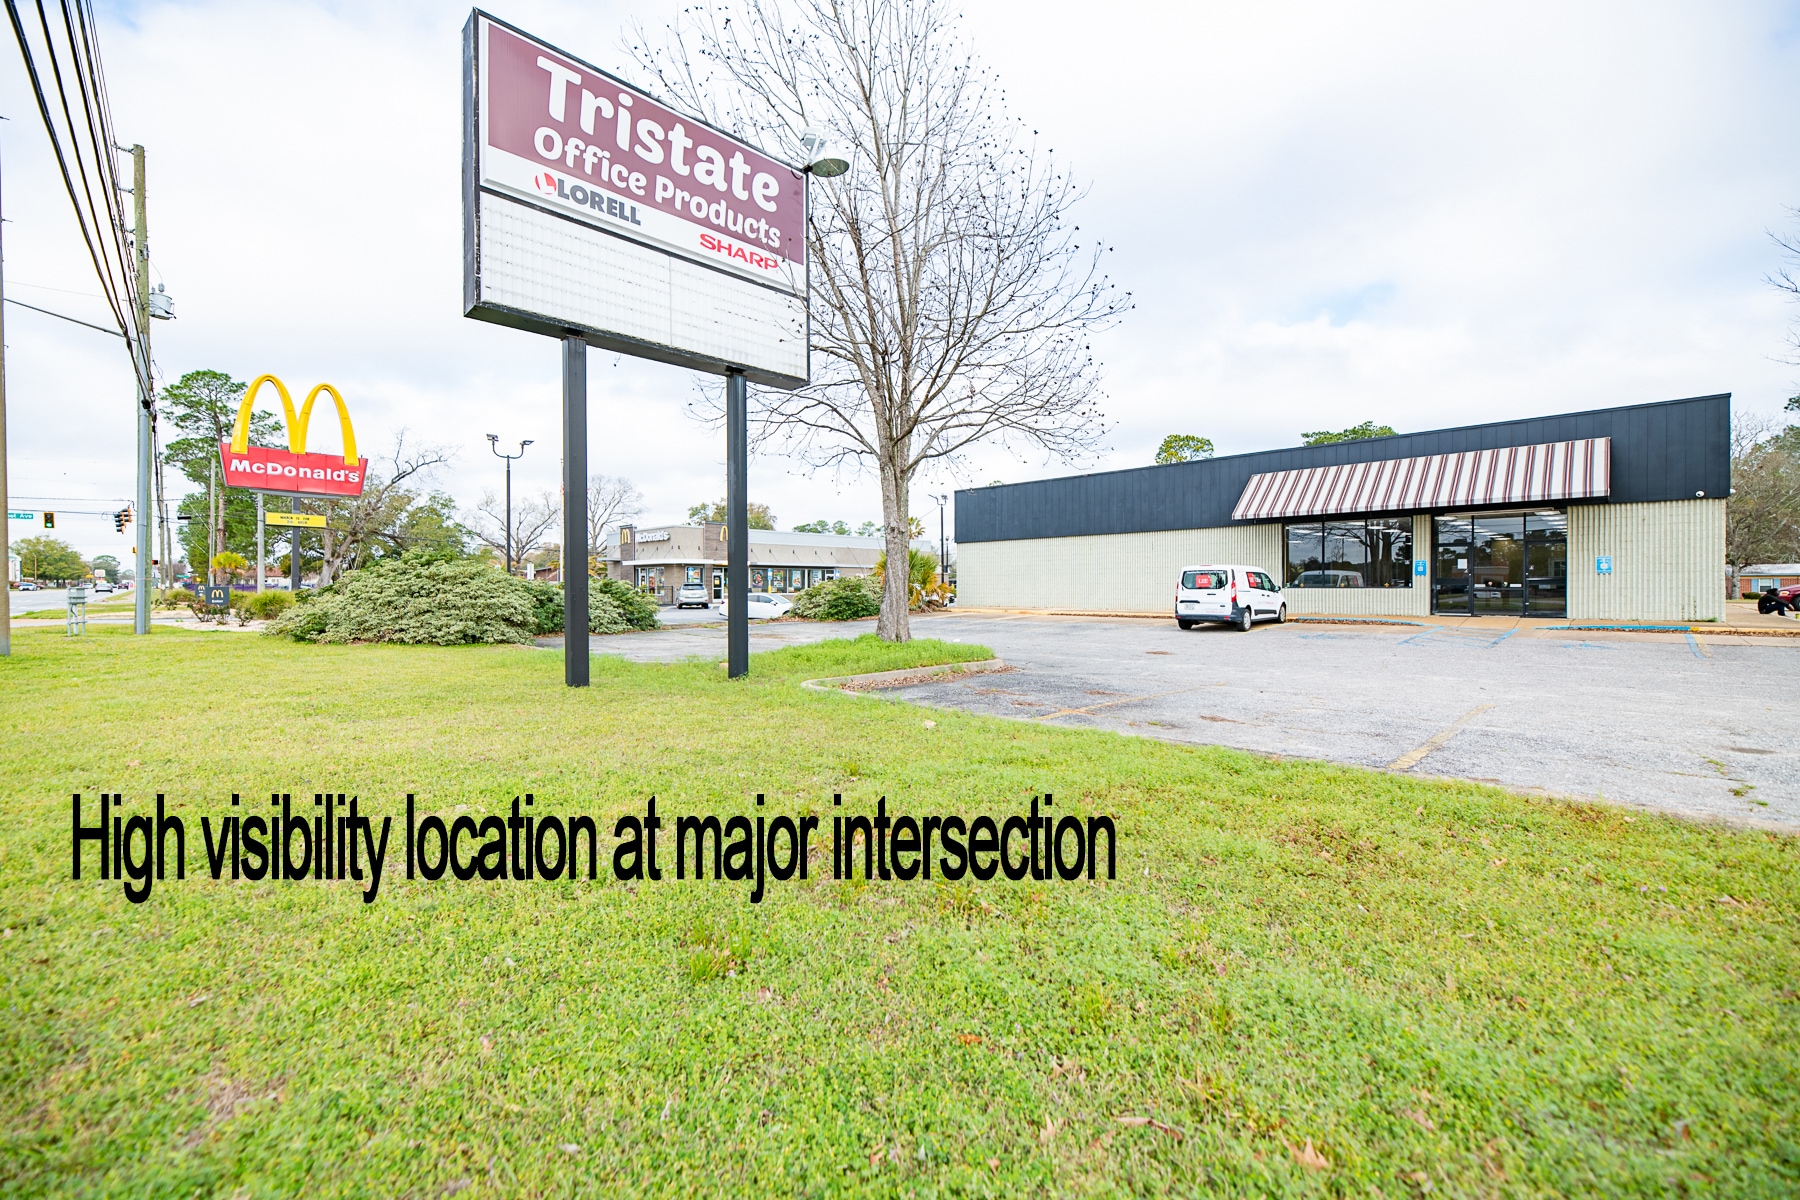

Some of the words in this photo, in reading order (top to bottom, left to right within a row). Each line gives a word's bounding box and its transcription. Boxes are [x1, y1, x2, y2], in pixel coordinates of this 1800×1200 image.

[536, 56, 779, 212] Tristate
[534, 127, 647, 196] Office
[655, 175, 780, 248] Products
[558, 178, 641, 226] LORELL
[700, 233, 778, 270] SHARP
[230, 459, 360, 483] McDonald's
